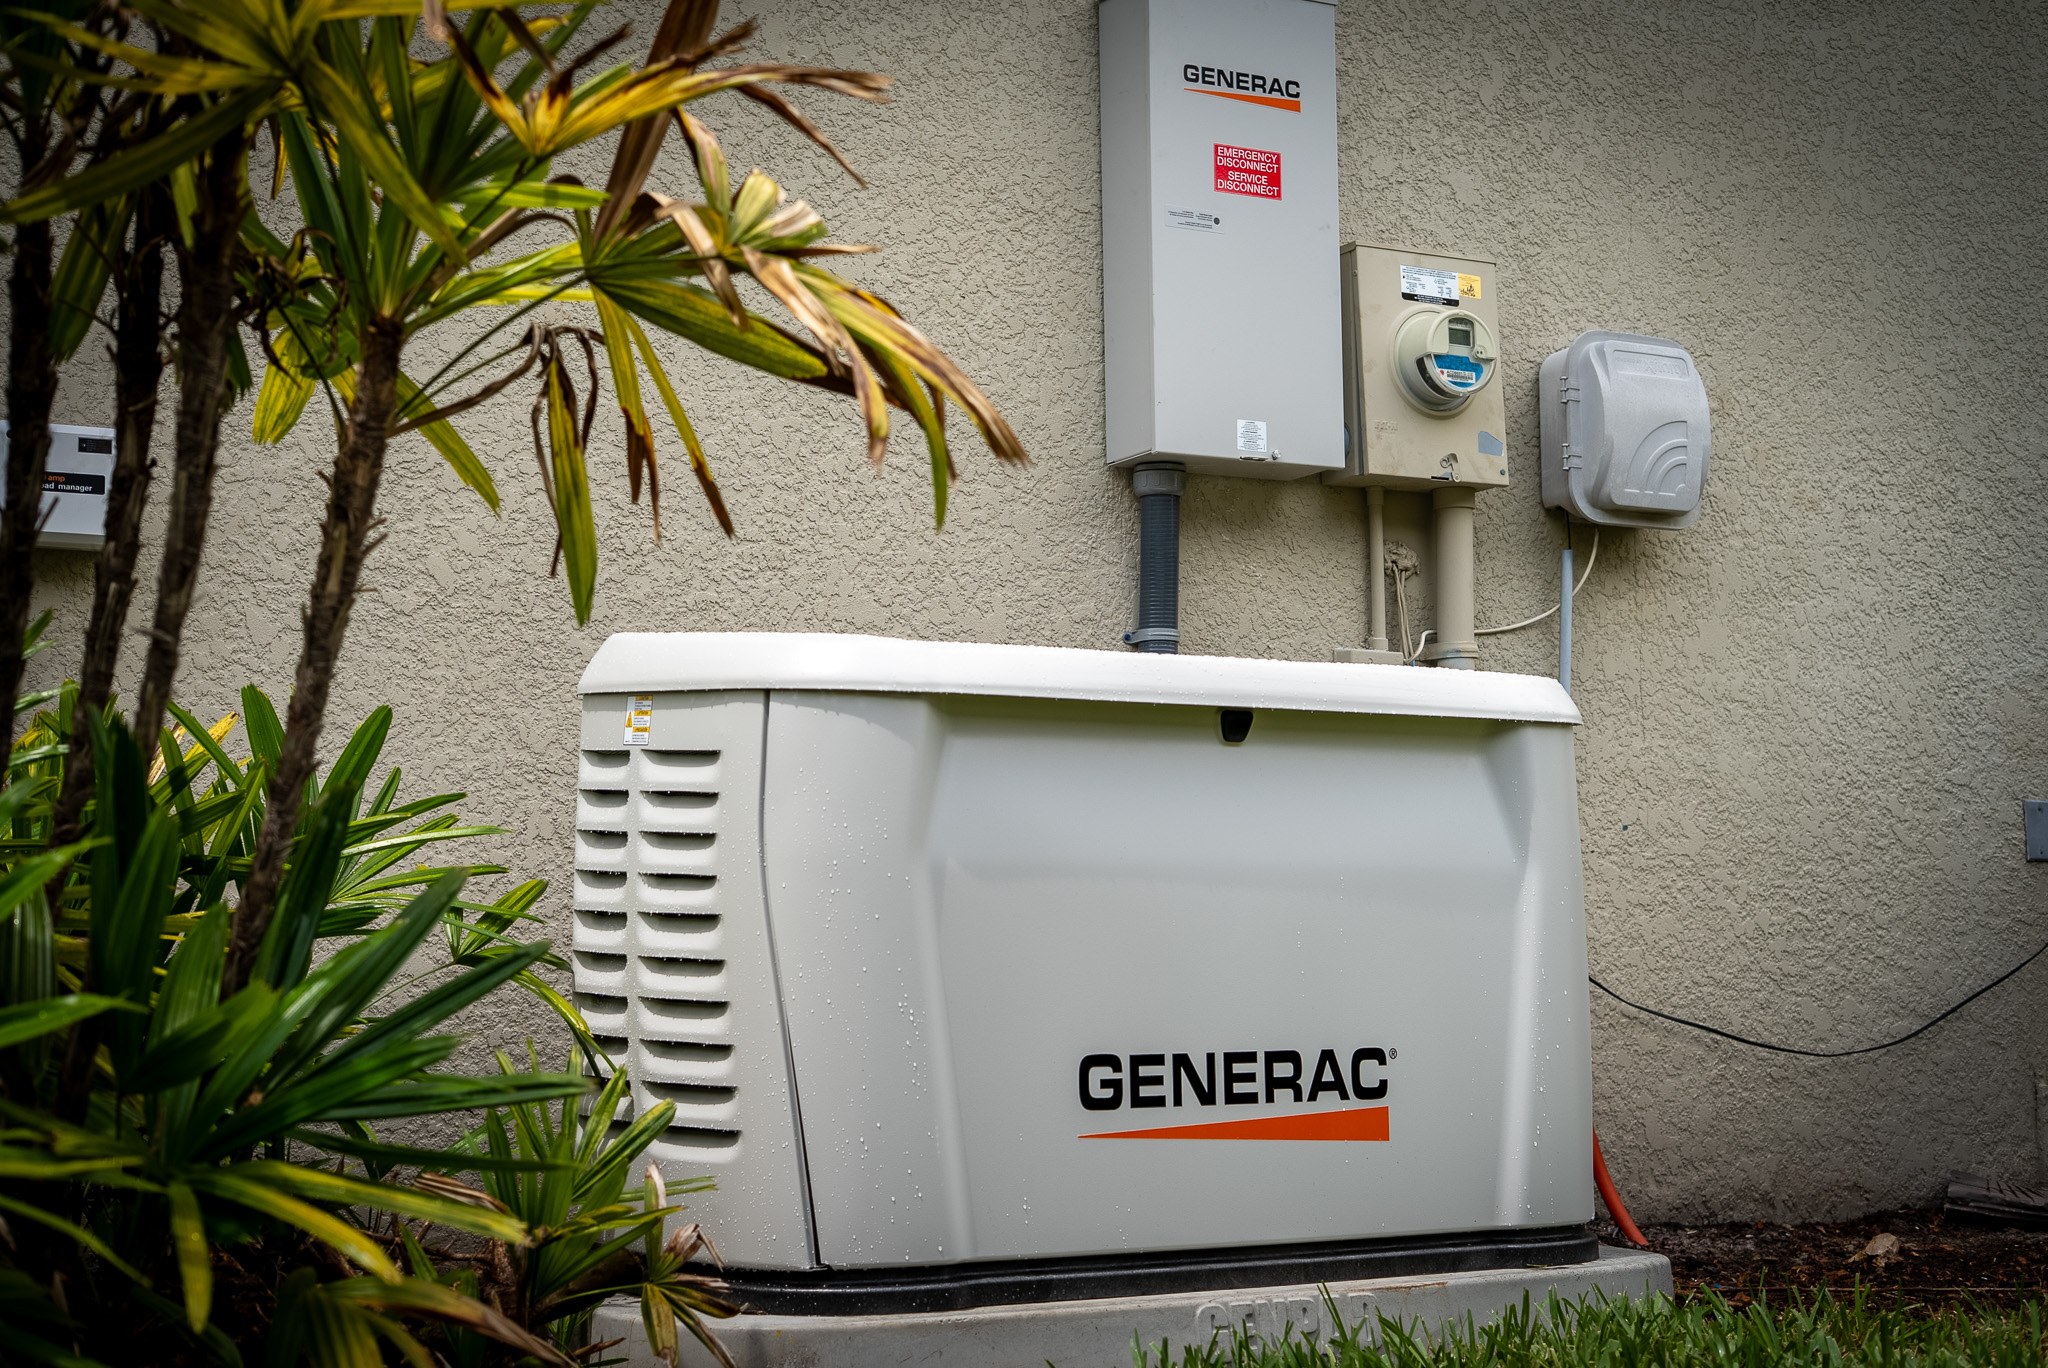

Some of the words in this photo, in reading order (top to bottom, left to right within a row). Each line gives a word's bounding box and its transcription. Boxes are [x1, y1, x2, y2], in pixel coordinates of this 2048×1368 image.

[1184, 64, 1301, 98] GENERAC
[1217, 147, 1278, 163] EMERGENCY
[1217, 157, 1279, 173] DISCONNECT
[1228, 171, 1268, 184] SERVICE
[1217, 179, 1279, 196] DISCONNECT
[48, 475, 65, 483] amp
[58, 484, 93, 493] manager
